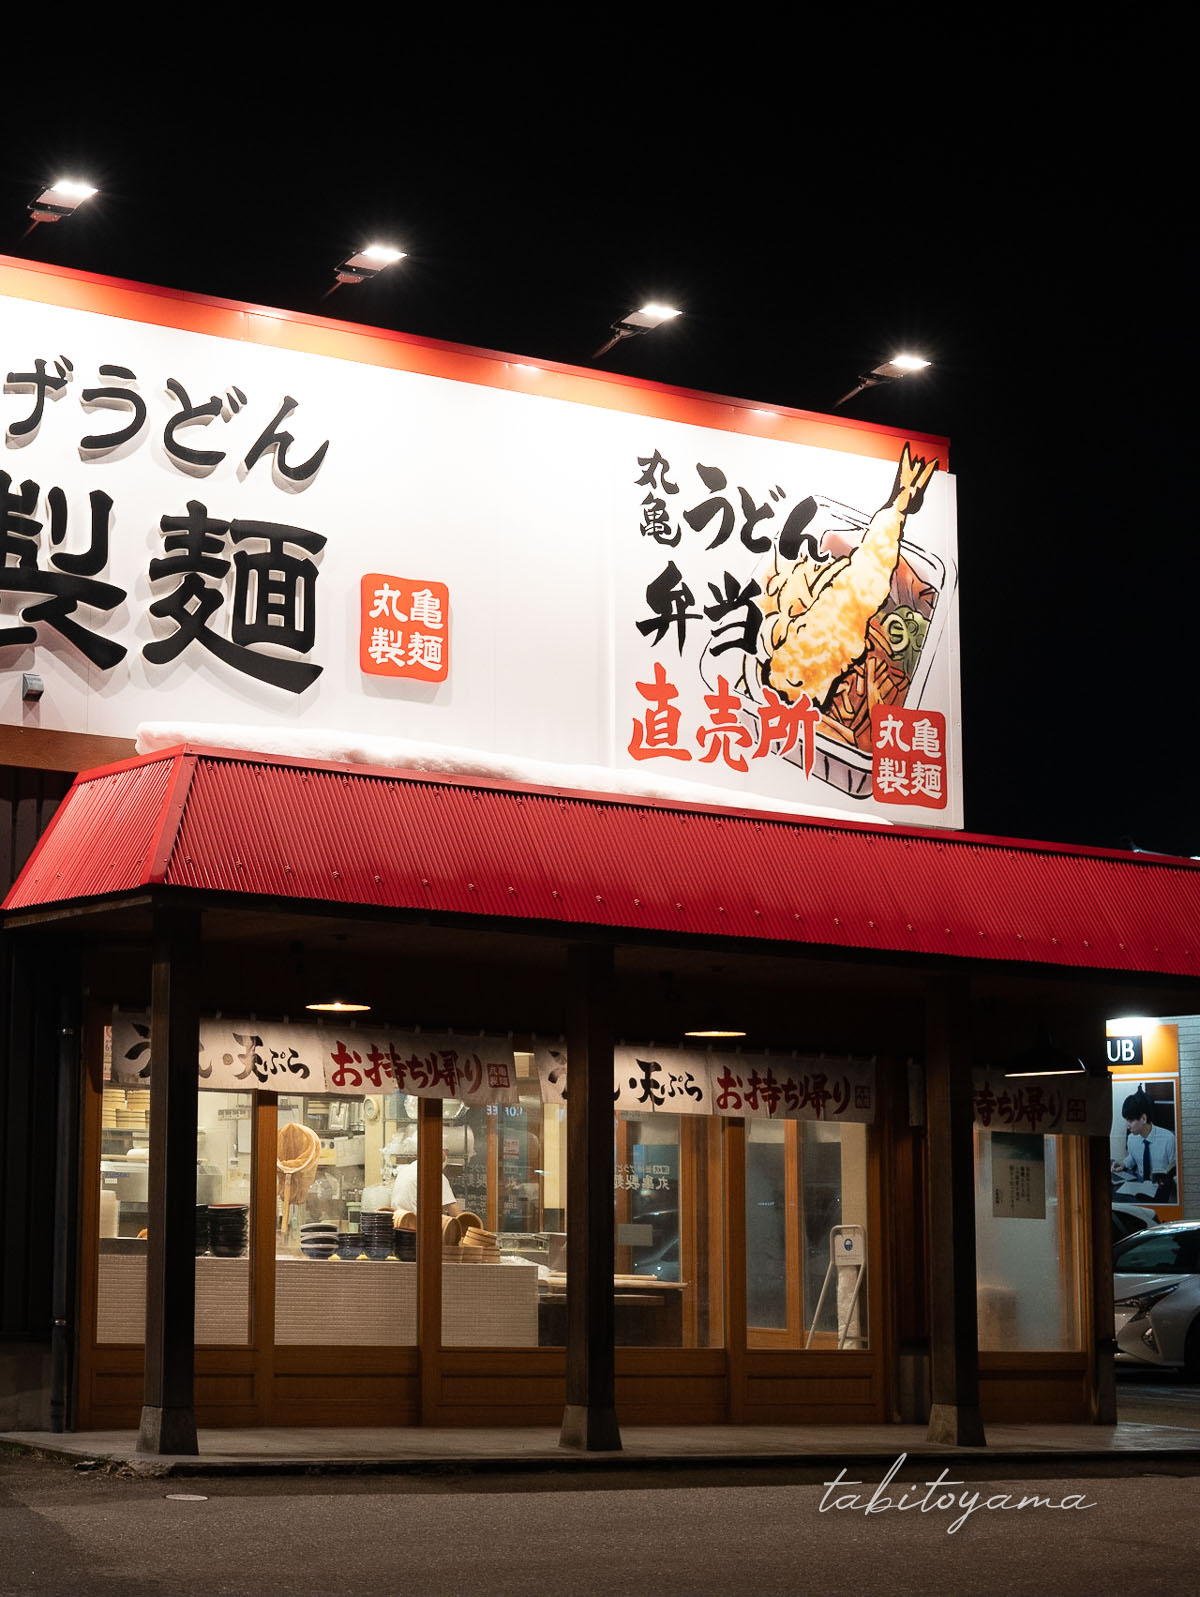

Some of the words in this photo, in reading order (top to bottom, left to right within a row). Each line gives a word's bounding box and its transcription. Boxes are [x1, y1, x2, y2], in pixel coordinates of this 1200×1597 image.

[634, 448, 681, 548] 丸亀
[683, 462, 832, 562] うどん
[368, 582, 444, 630] 丸亀
[635, 560, 763, 657] 弁当
[368, 626, 443, 672] 製麺
[628, 662, 821, 781] 直売所
[877, 714, 943, 758] 丸亀
[876, 757, 943, 800] 製麺
[331, 1040, 483, 1097] お持ち帰り
[716, 1064, 851, 1119] お持ち帰り
